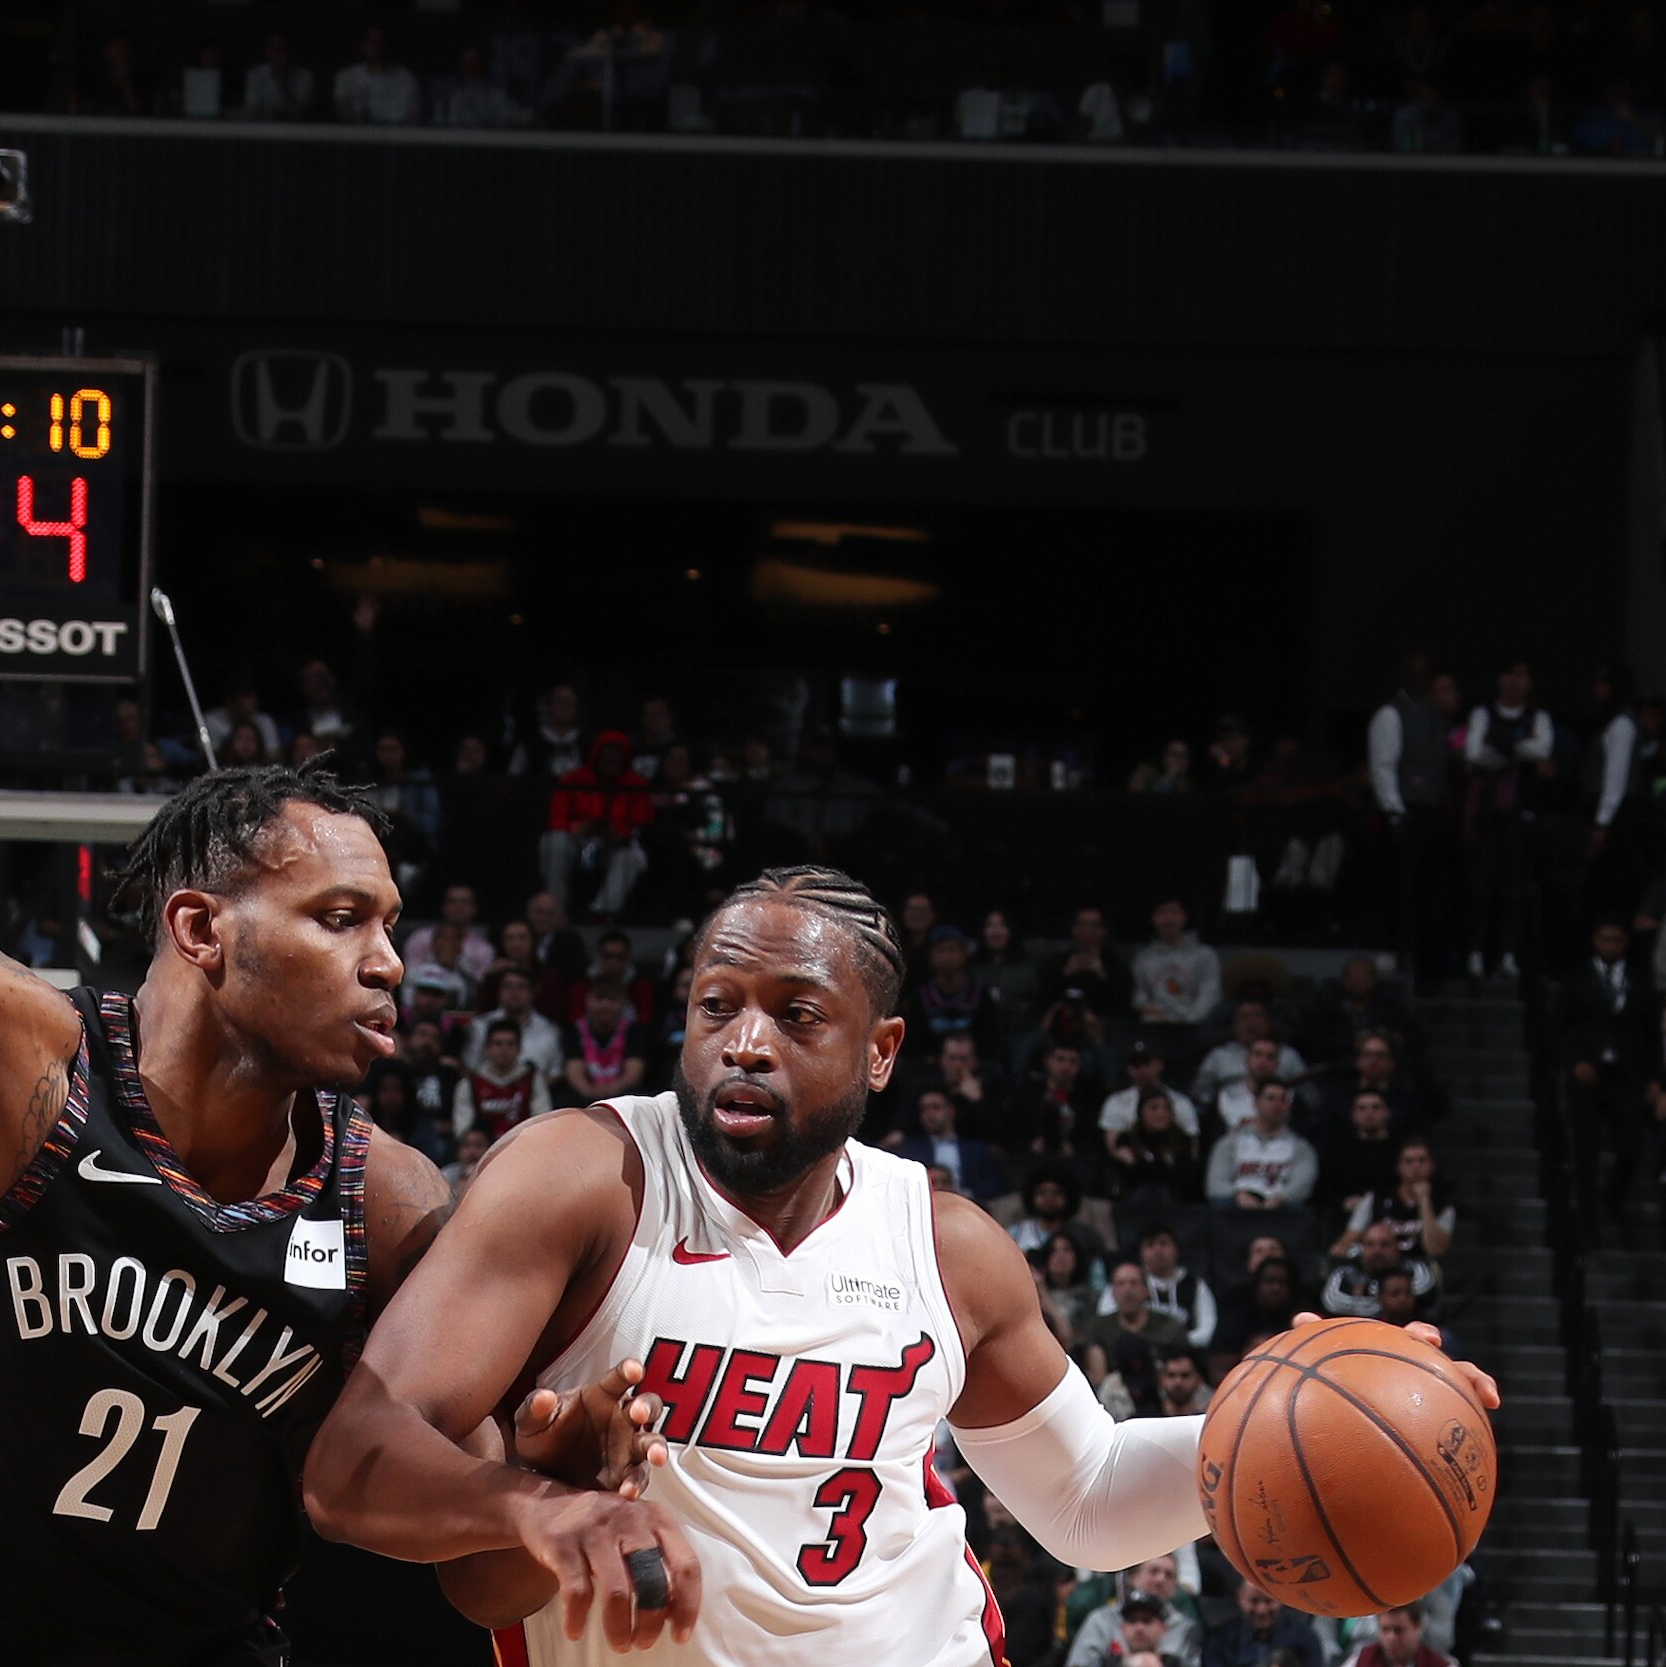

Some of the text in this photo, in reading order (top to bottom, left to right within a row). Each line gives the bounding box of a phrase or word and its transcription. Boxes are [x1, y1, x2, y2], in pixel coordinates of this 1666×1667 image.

[373, 367, 959, 456] HONDA
[1006, 409, 1149, 461] CLUB
[289, 1235, 339, 1264] infor
[831, 1272, 901, 1300] Ultimate
[835, 1294, 900, 1311] SOFTWARE
[6, 1252, 324, 1419] BROOKLYN
[633, 1330, 935, 1461] HEAT
[52, 1387, 202, 1531] 21
[796, 1467, 884, 1587] 3
